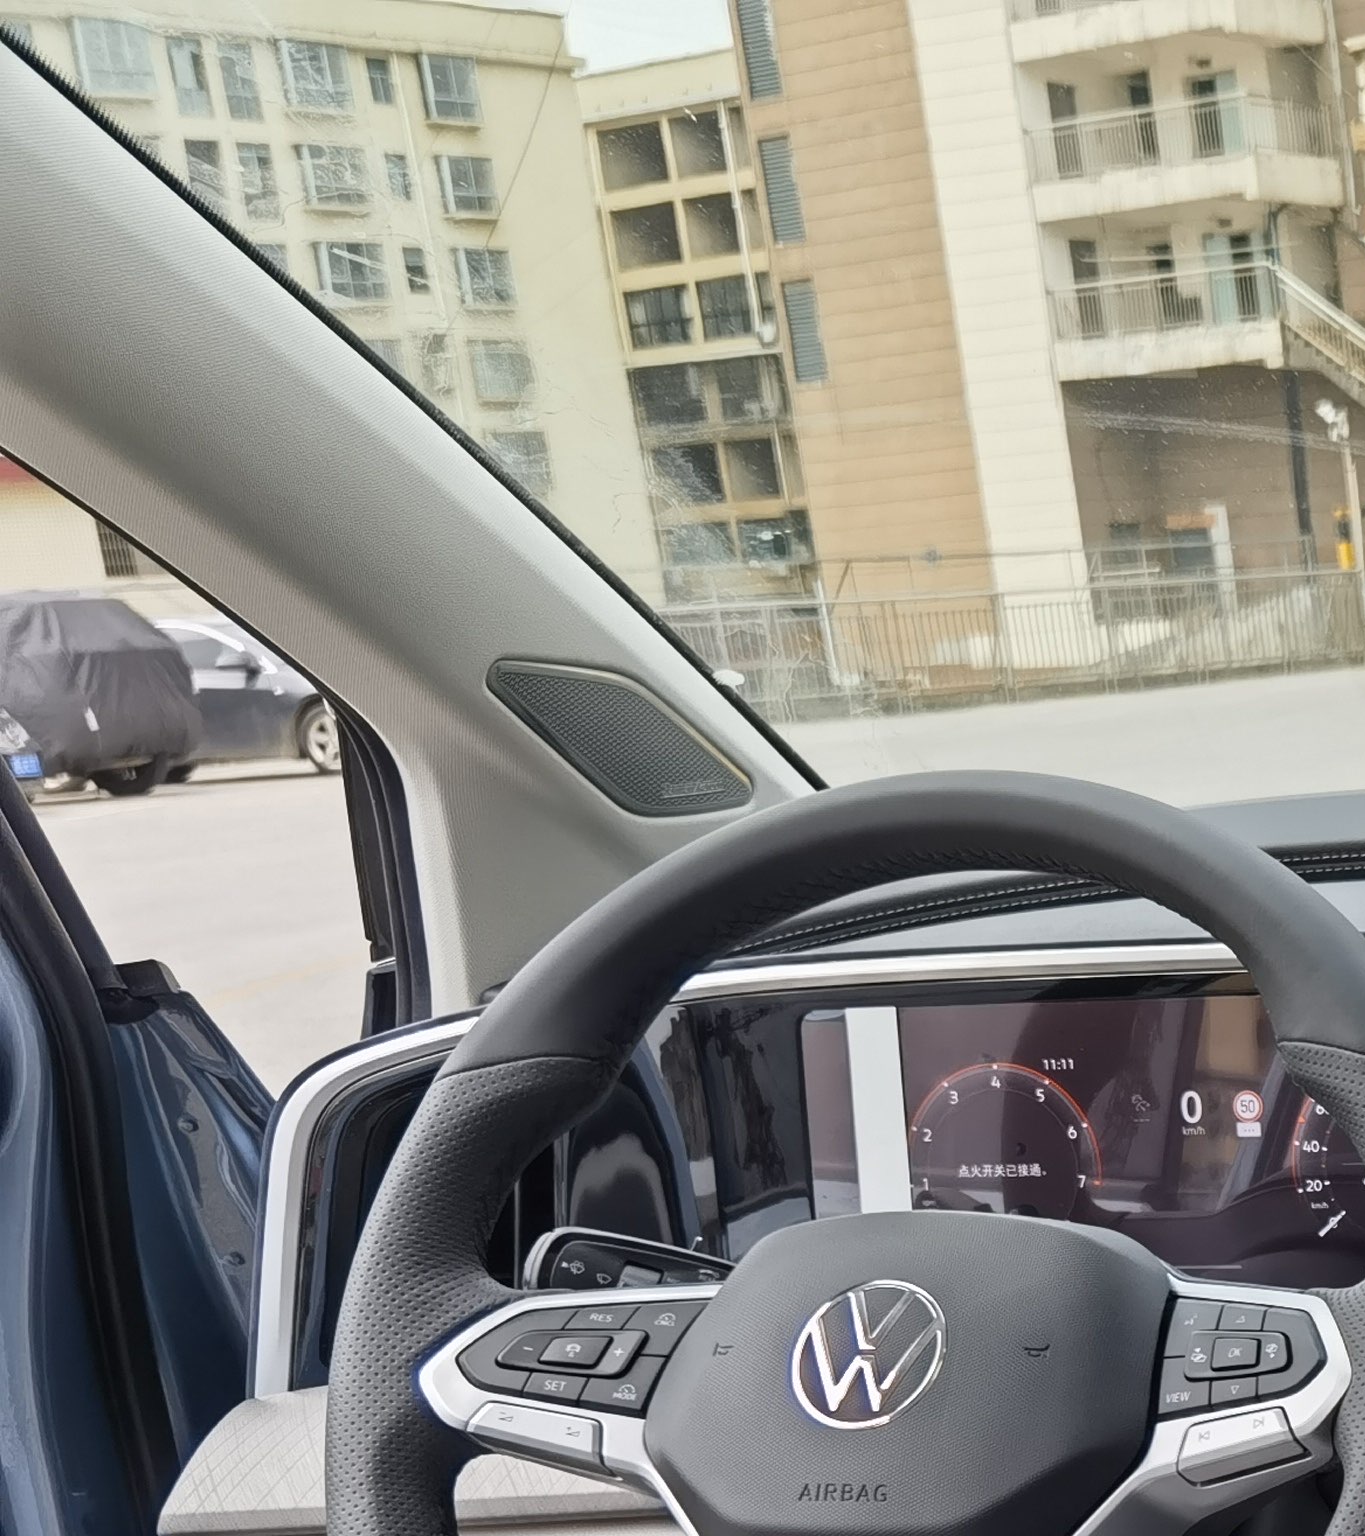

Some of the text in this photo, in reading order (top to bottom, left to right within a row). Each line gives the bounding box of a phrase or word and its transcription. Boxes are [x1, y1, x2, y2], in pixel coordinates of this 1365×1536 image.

[1043, 1059, 1074, 1071] 11:11
[991, 1076, 1001, 1088] 4
[950, 1091, 959, 1104] 3
[1035, 1089, 1045, 1102] 5
[1181, 1090, 1202, 1123] 0
[1240, 1100, 1256, 1113] 50
[923, 1129, 932, 1142] 2
[1067, 1126, 1078, 1139] 6
[1182, 1126, 1206, 1136] km/h
[1302, 1141, 1320, 1153] 40
[958, 1163, 1047, 1177] 点火开关已接通。
[923, 1178, 930, 1191] 1
[1078, 1175, 1086, 1188] 7
[1305, 1180, 1322, 1192] 20
[589, 1312, 614, 1323] RES
[1228, 1348, 1242, 1358] OK
[543, 1380, 567, 1391] SET
[1166, 1391, 1191, 1404] VIEW
[799, 1483, 888, 1503] AIRBAG
